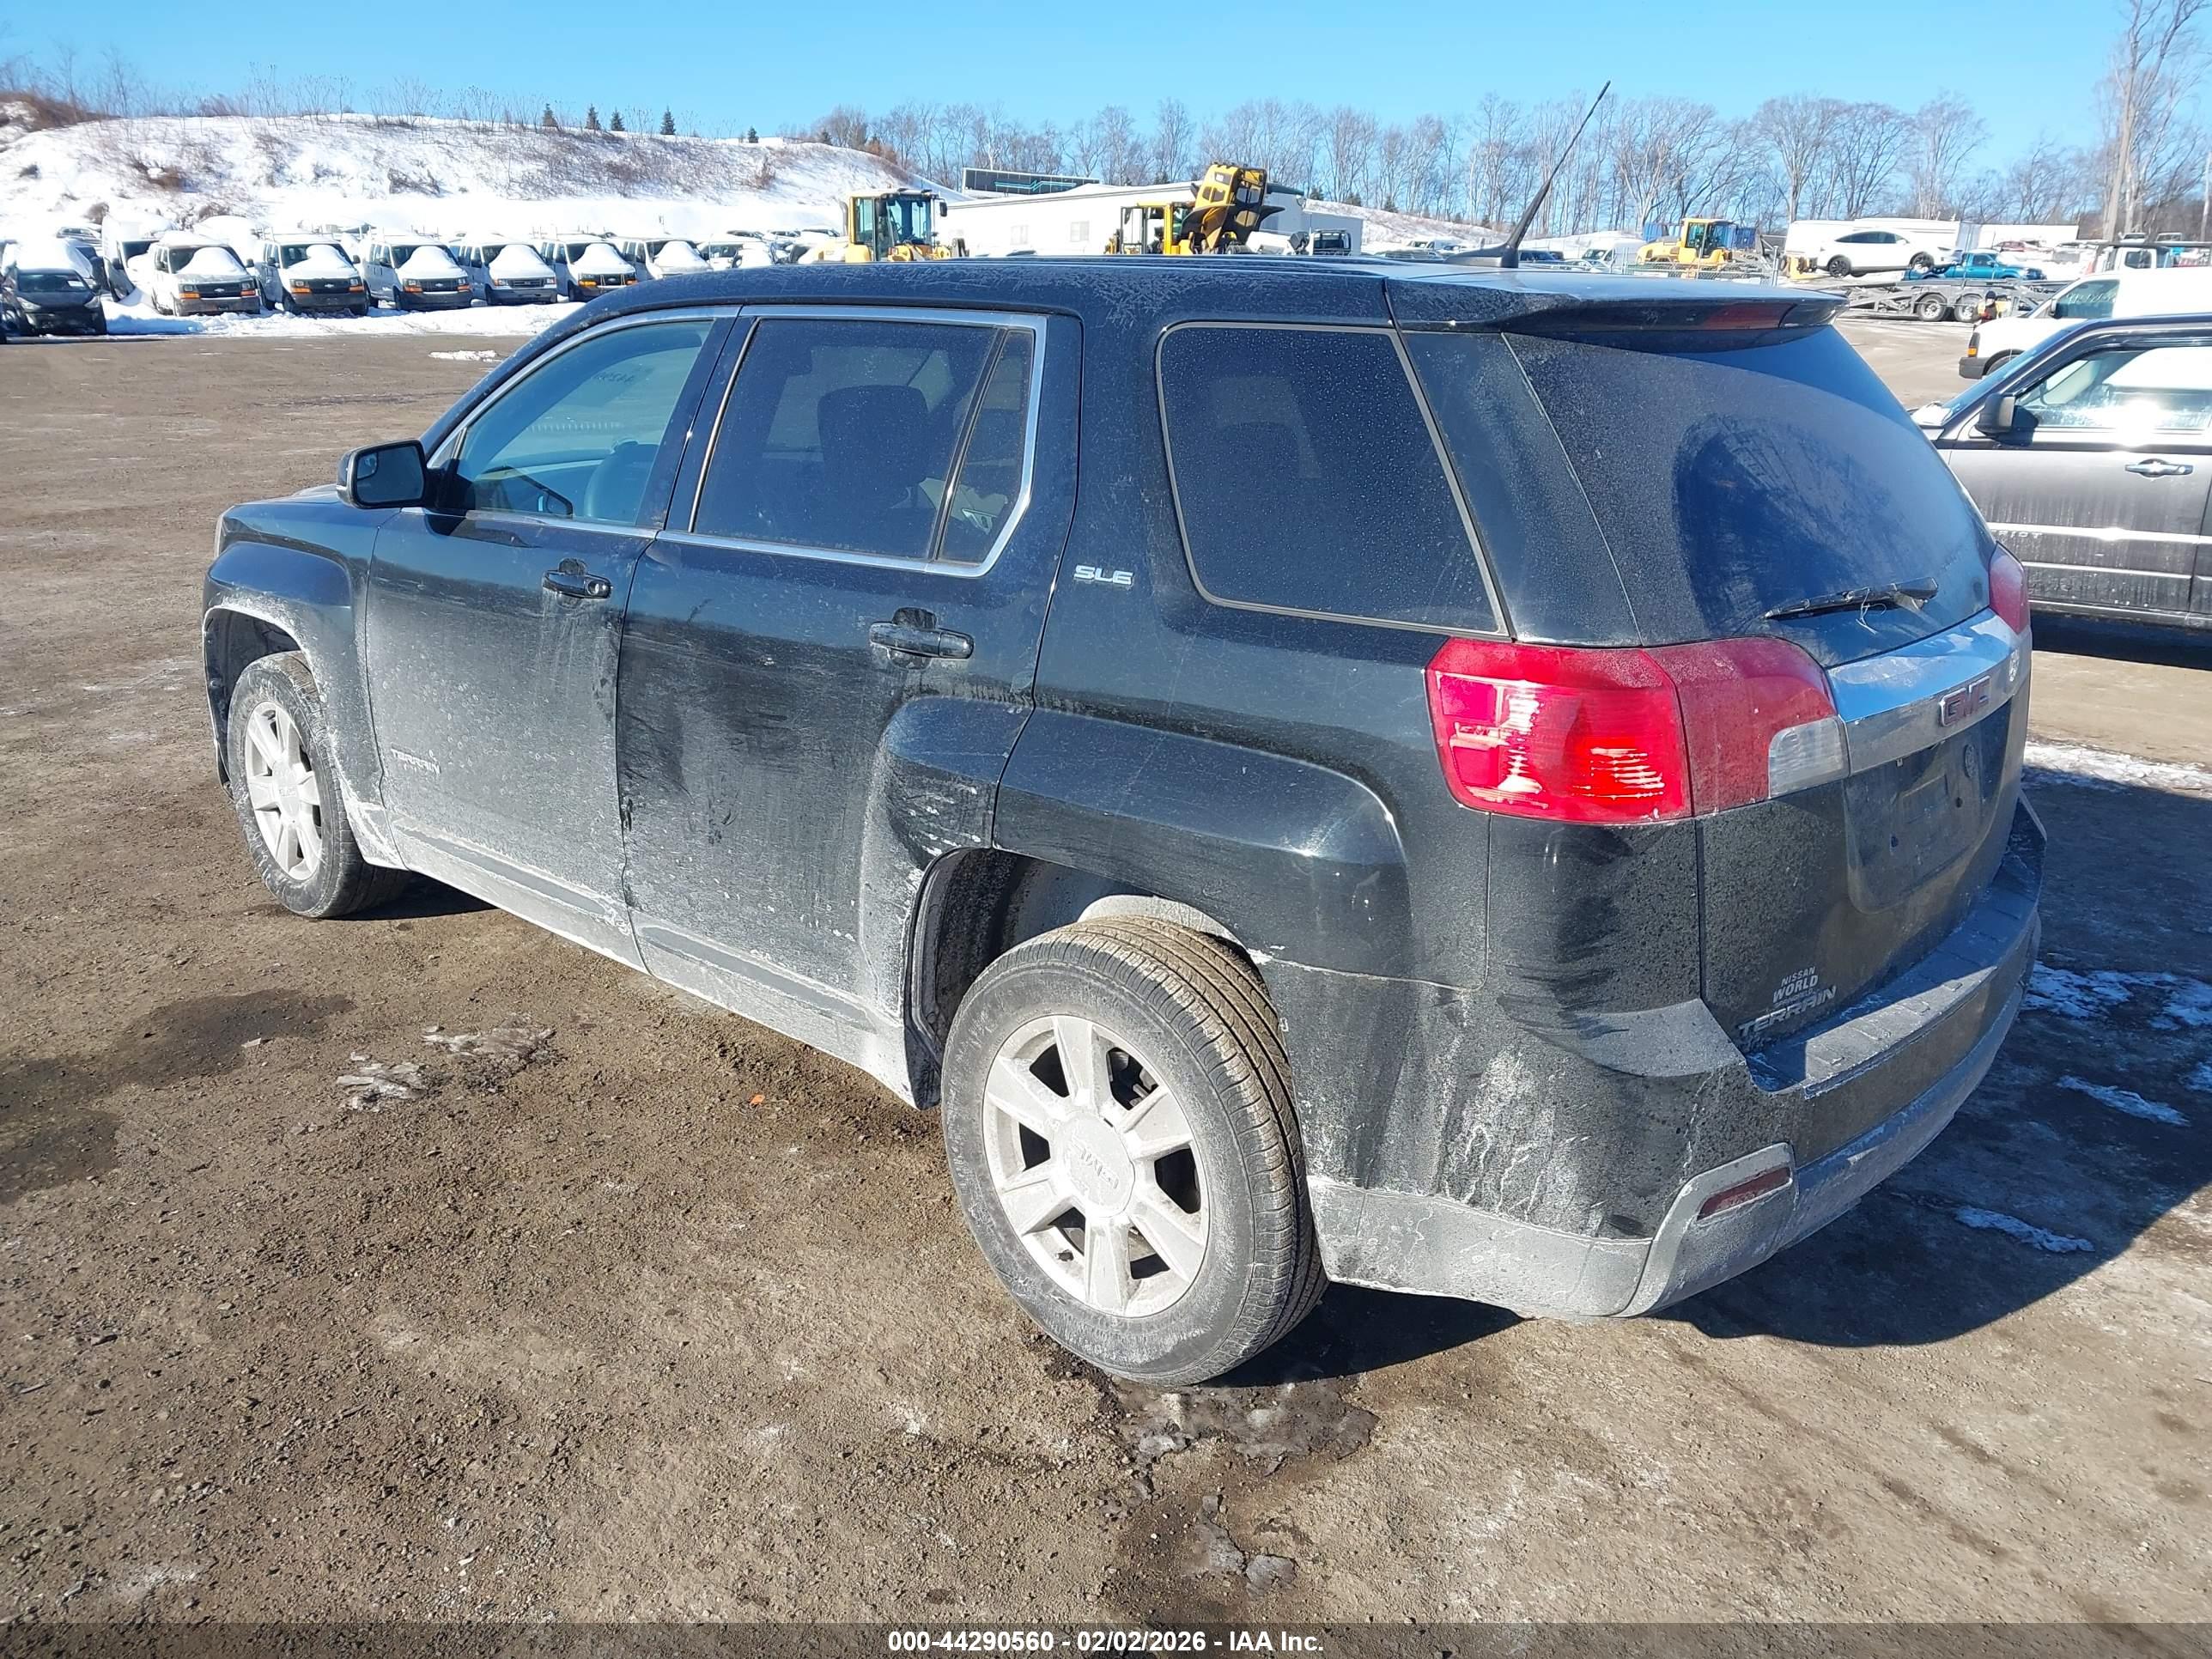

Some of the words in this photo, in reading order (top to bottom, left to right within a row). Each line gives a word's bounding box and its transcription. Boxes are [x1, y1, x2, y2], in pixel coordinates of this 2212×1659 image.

[1073, 565, 1134, 585] SLE
[1772, 975, 1819, 1004] WORLD
[1780, 966, 1816, 988] NISSAN
[1738, 985, 1837, 1036] TERRAIN
